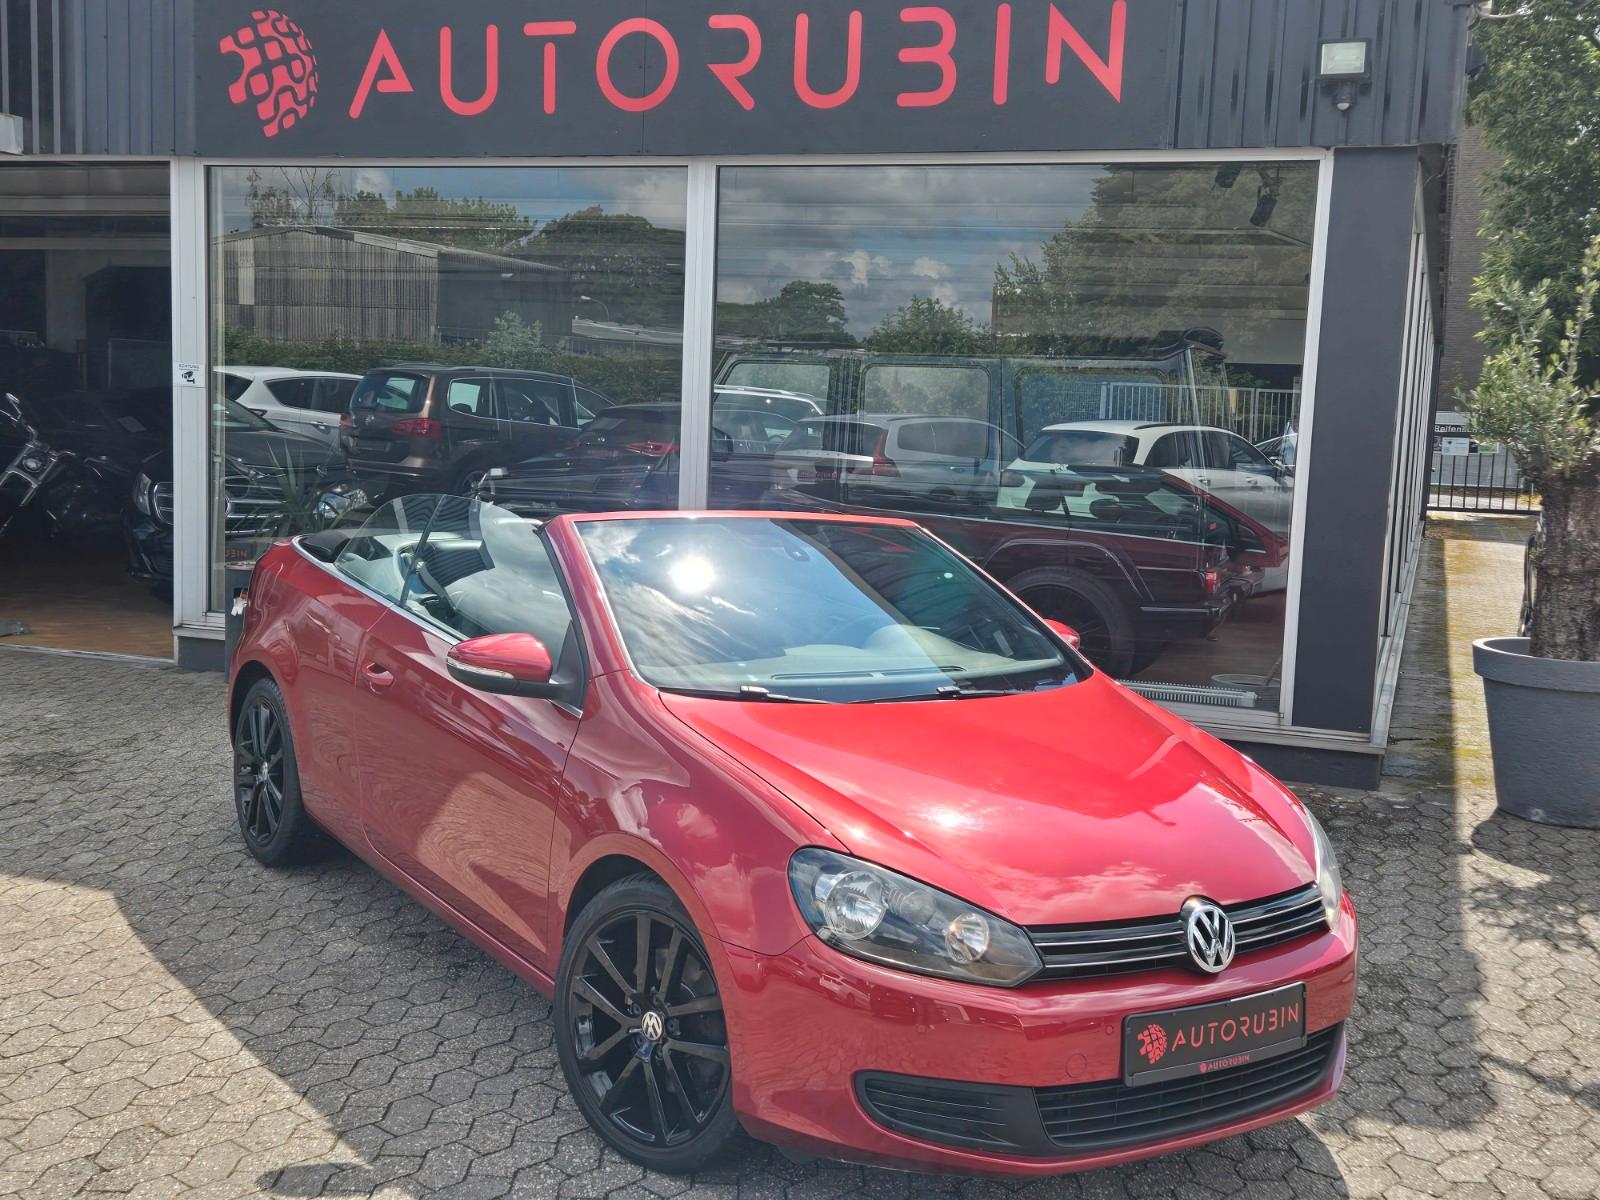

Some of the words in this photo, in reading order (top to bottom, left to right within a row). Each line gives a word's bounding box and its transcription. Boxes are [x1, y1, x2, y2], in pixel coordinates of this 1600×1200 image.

[349, 0, 1127, 118] AUTORUBIN
[1171, 1004, 1299, 1051] AUTORUBIN
[1207, 1054, 1250, 1071] AUTORUBIN
